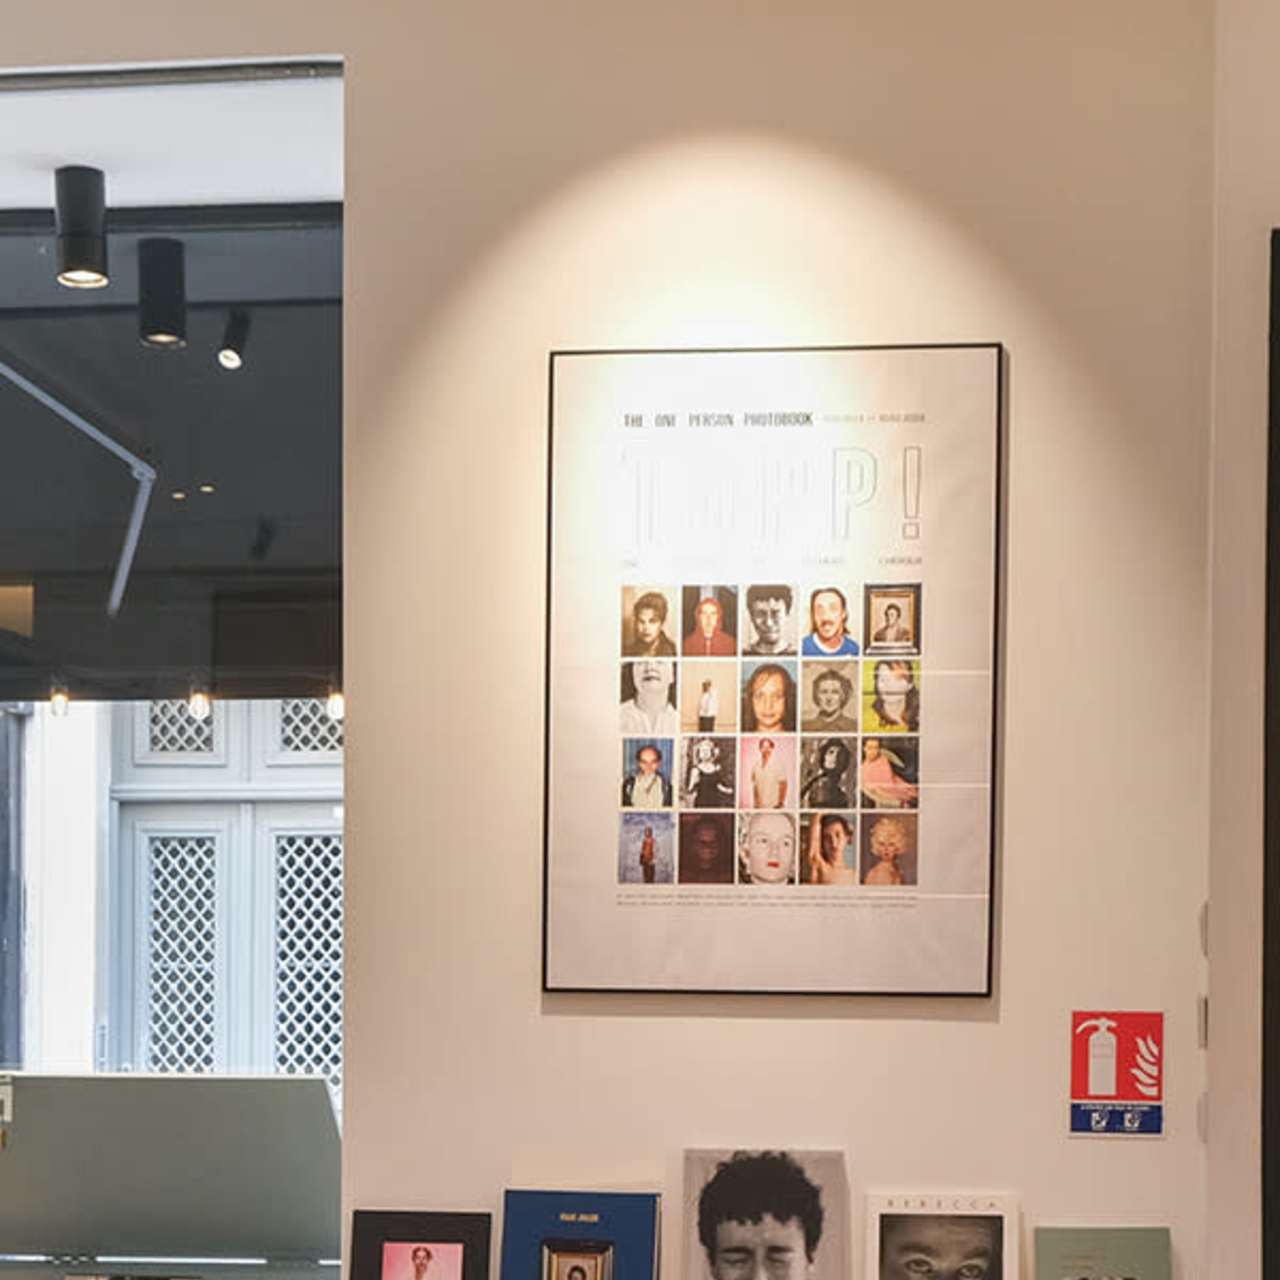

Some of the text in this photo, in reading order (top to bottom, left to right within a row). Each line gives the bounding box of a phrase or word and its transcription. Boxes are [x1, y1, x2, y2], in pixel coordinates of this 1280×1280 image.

[689, 413, 734, 427] PERSON
[743, 412, 813, 427] PHOTOBOOK
[887, 1199, 997, 1211] REBECCA
